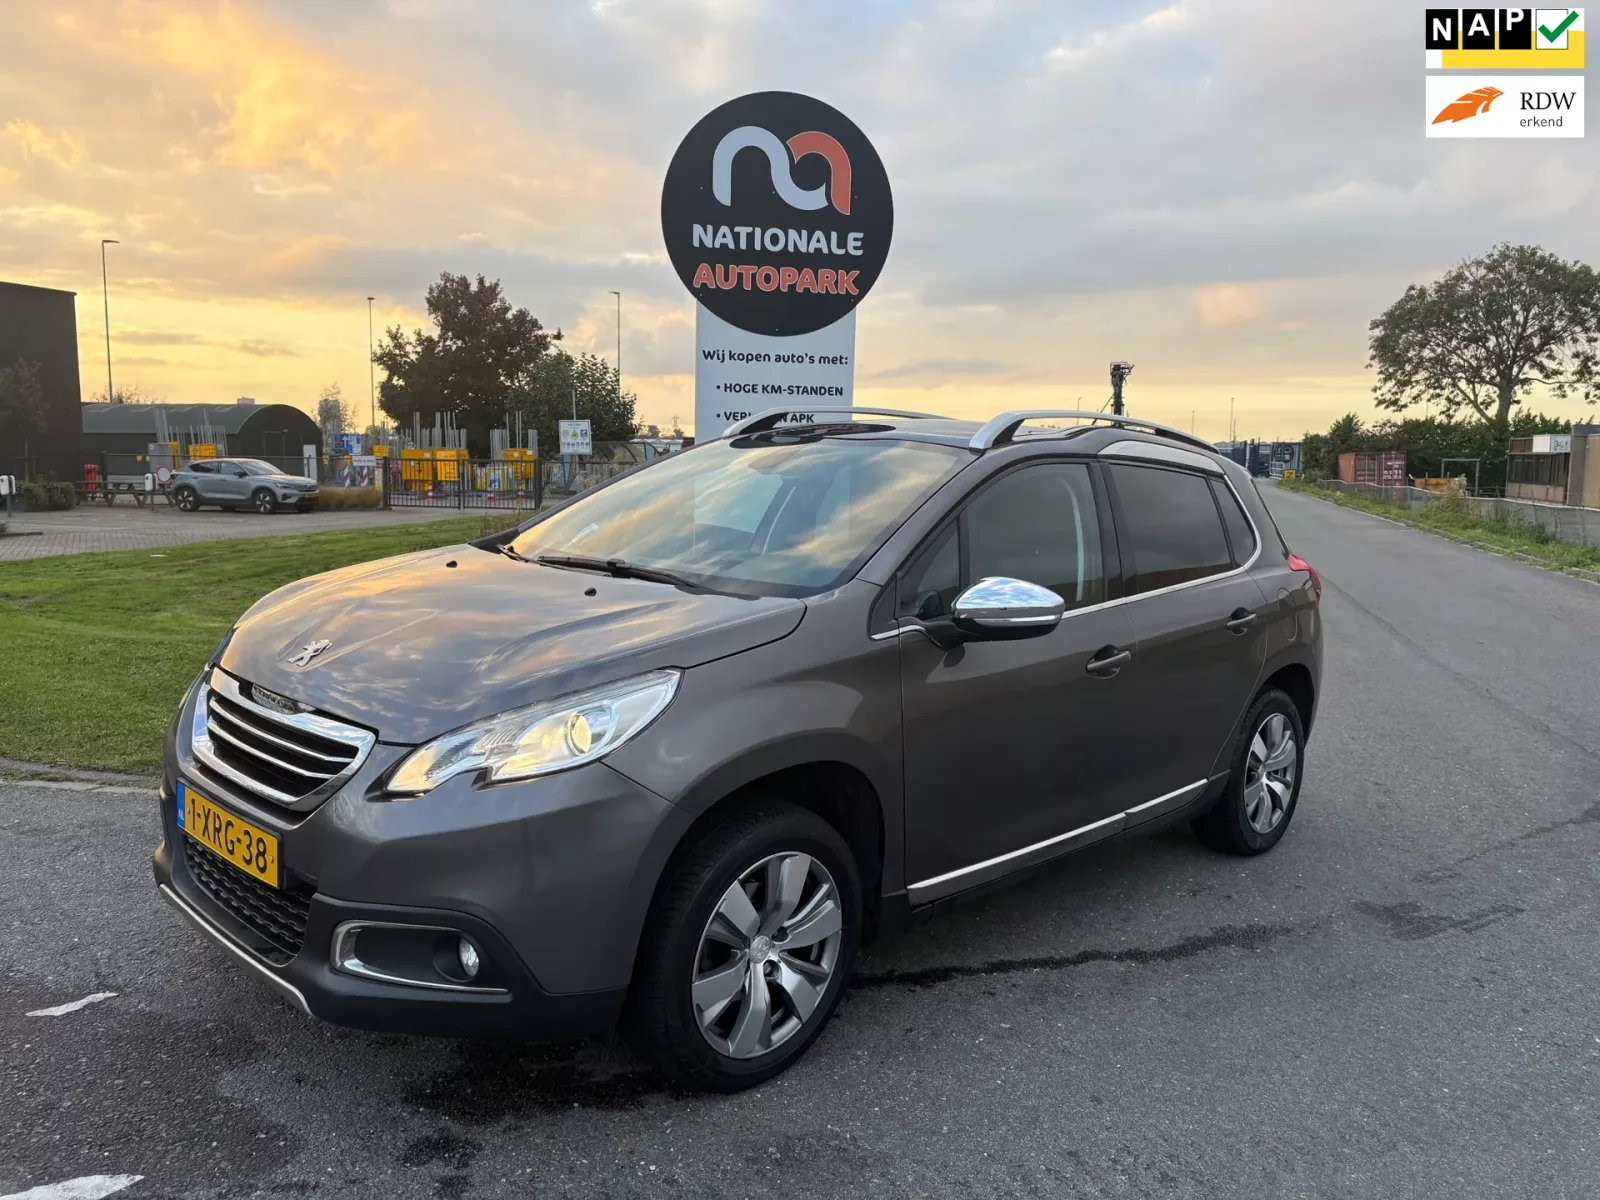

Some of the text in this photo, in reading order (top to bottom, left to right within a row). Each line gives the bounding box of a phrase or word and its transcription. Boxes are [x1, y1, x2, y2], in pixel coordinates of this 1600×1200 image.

[692, 224, 864, 256] NATIONALE
[693, 263, 860, 295] AUTOPARK
[702, 350, 848, 365] Wij kopen auto's met:
[724, 383, 843, 396] HOGE KM-STANDEN
[790, 413, 815, 423] APK
[191, 798, 268, 874] 1-XRG-38
